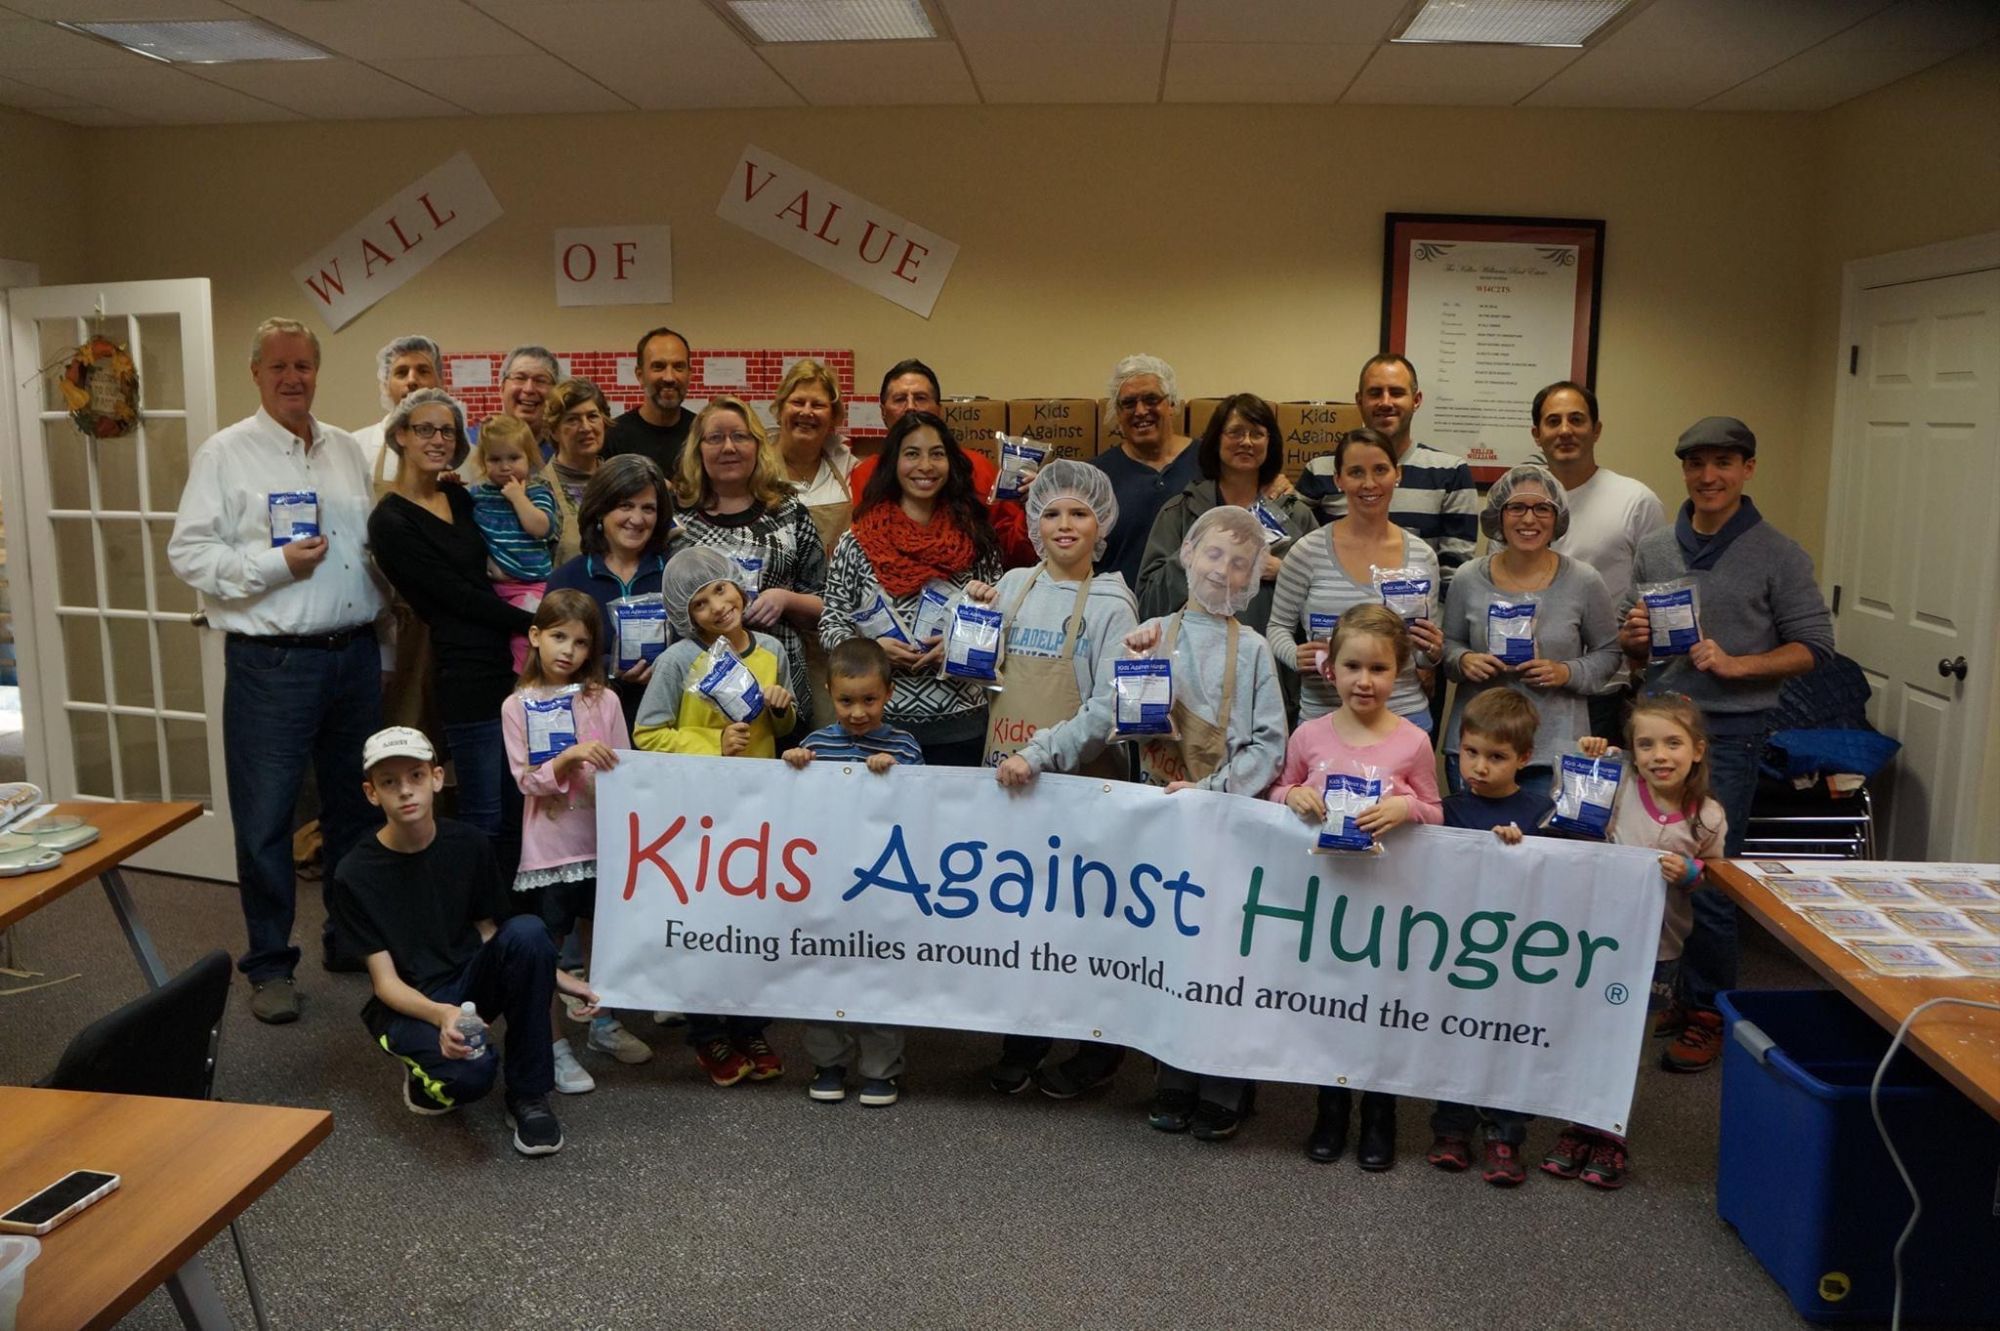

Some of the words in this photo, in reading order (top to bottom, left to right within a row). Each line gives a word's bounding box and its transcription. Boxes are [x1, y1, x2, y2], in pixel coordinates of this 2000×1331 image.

[739, 161, 930, 284] VALUE
[304, 191, 456, 306] WALL
[562, 241, 638, 283] OF
[945, 407, 981, 422] Kids
[1034, 404, 1070, 420] Kids
[1301, 409, 1337, 424] Kids
[1022, 424, 1083, 441] Against
[1286, 428, 1347, 444] Agains
[623, 811, 818, 905] Kids
[841, 824, 1206, 937] Against
[1239, 866, 1620, 990] Hunger
[665, 919, 780, 961] Feeding
[790, 928, 906, 960] families
[917, 940, 1020, 970] around
[1030, 943, 1078, 974] the
[1254, 984, 1368, 1024] around
[1379, 1000, 1430, 1032] the
[1440, 1016, 1551, 1048] corner.
